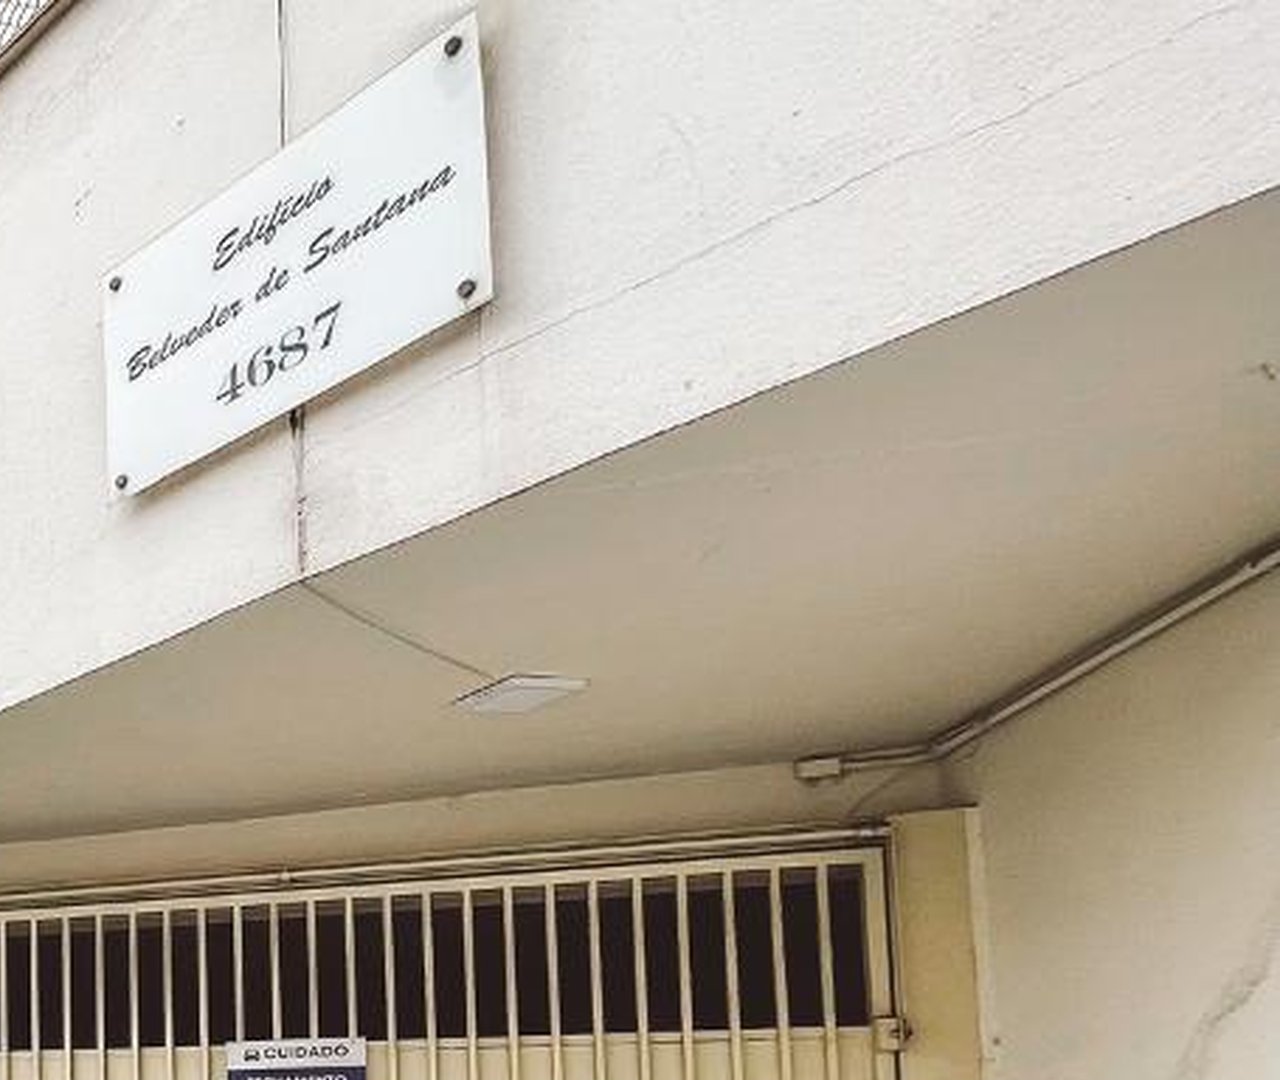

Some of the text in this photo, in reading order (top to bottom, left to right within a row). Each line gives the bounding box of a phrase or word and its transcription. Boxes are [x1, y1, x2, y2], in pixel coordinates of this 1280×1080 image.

[126, 165, 458, 383] Belveder de Santana
[216, 302, 342, 406] 4687
[263, 1044, 350, 1060] CUIDADO
